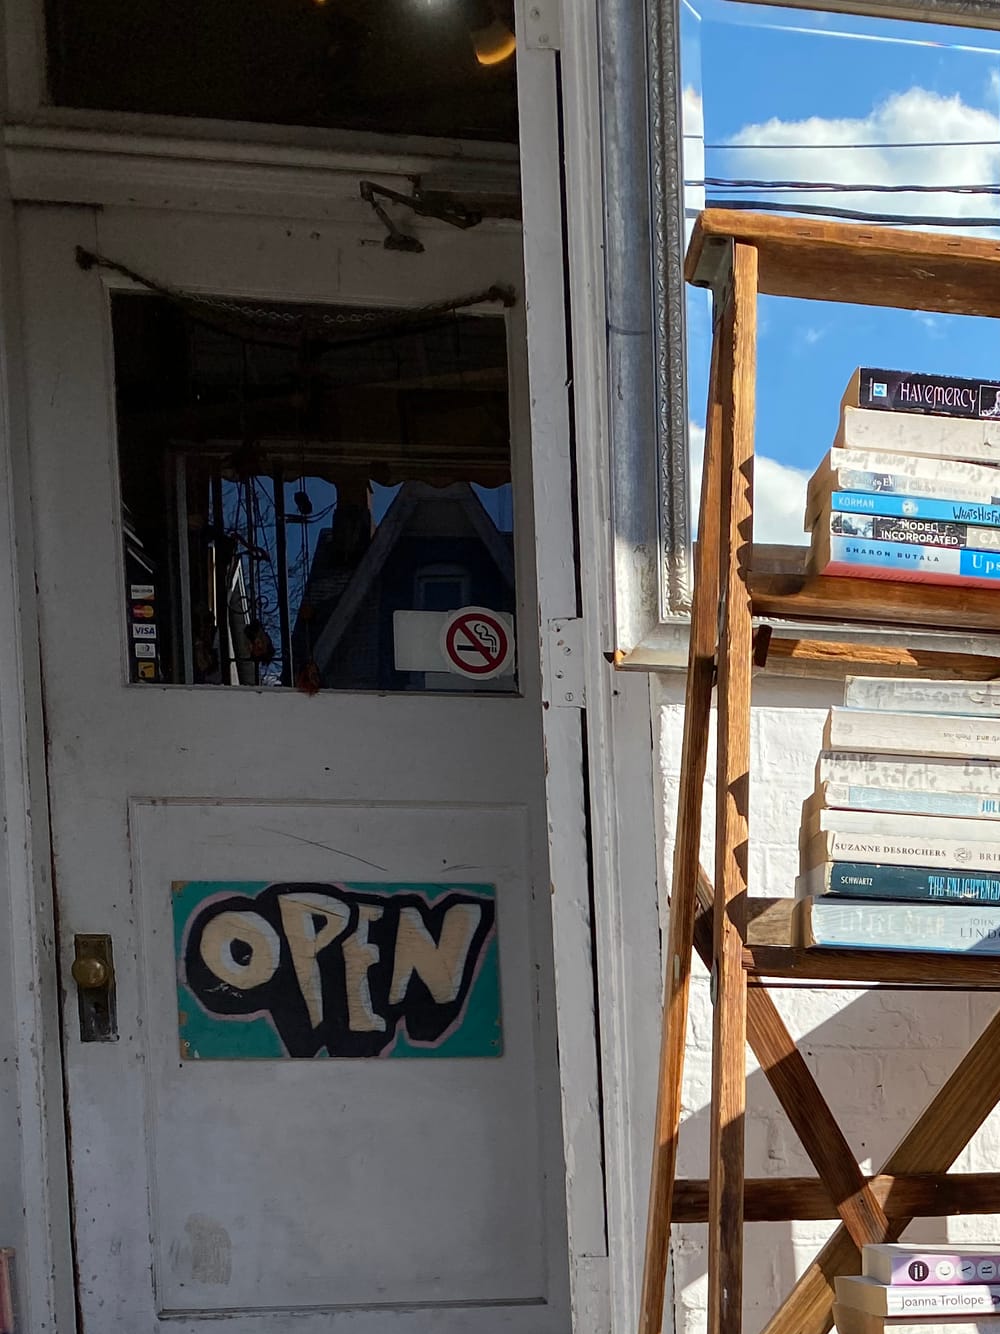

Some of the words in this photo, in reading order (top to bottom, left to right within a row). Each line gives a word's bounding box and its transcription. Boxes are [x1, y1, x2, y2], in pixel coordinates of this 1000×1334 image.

[838, 496, 874, 509] KORMAN
[881, 530, 959, 546] INCORPORATED
[845, 546, 893, 558] SHARON
[897, 551, 940, 563] BUTALA
[136, 627, 155, 635] VISA
[835, 842, 881, 854] SUZANNE
[883, 846, 947, 858] DESROCHERS
[840, 875, 873, 886] SCHWARTZ
[928, 876, 945, 897] THE
[947, 877, 1000, 900] ENLIGHTENED
[200, 891, 482, 1032] OPEN
[901, 1295, 937, 1309] Joanna
[938, 1294, 985, 1308] Trollope
